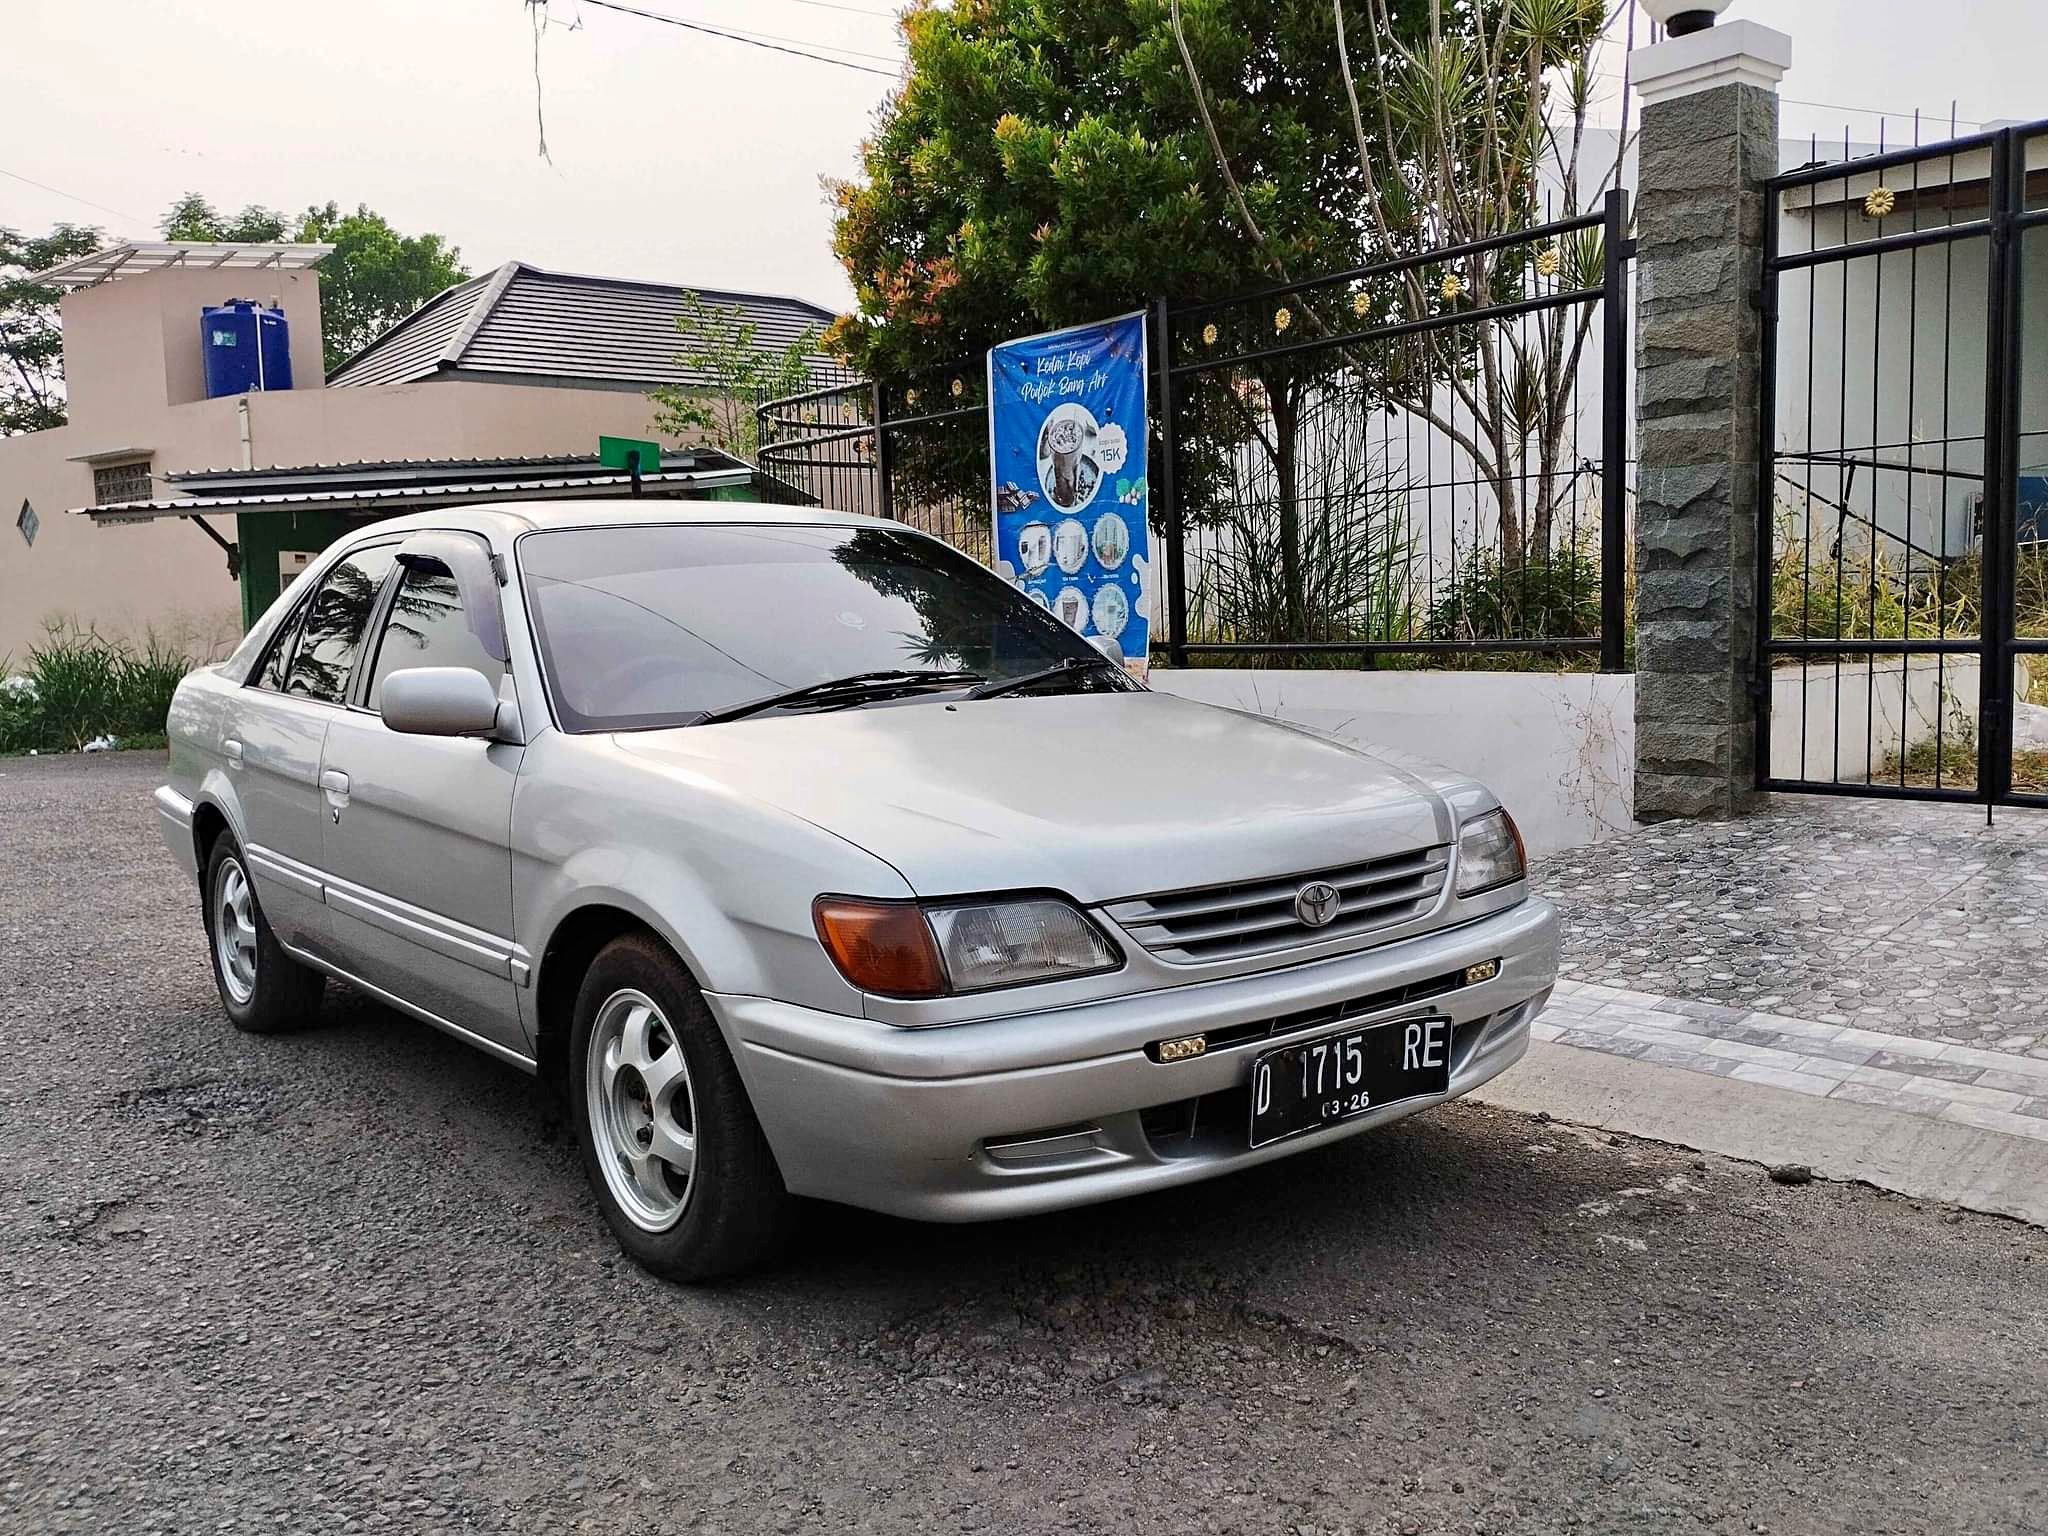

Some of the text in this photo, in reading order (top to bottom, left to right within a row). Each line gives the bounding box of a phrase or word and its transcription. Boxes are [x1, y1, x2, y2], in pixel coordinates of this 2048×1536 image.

[1067, 350, 1091, 371] Kopi
[1100, 448, 1121, 462] 15K
[1257, 1021, 1446, 1116] D 1715 RE
